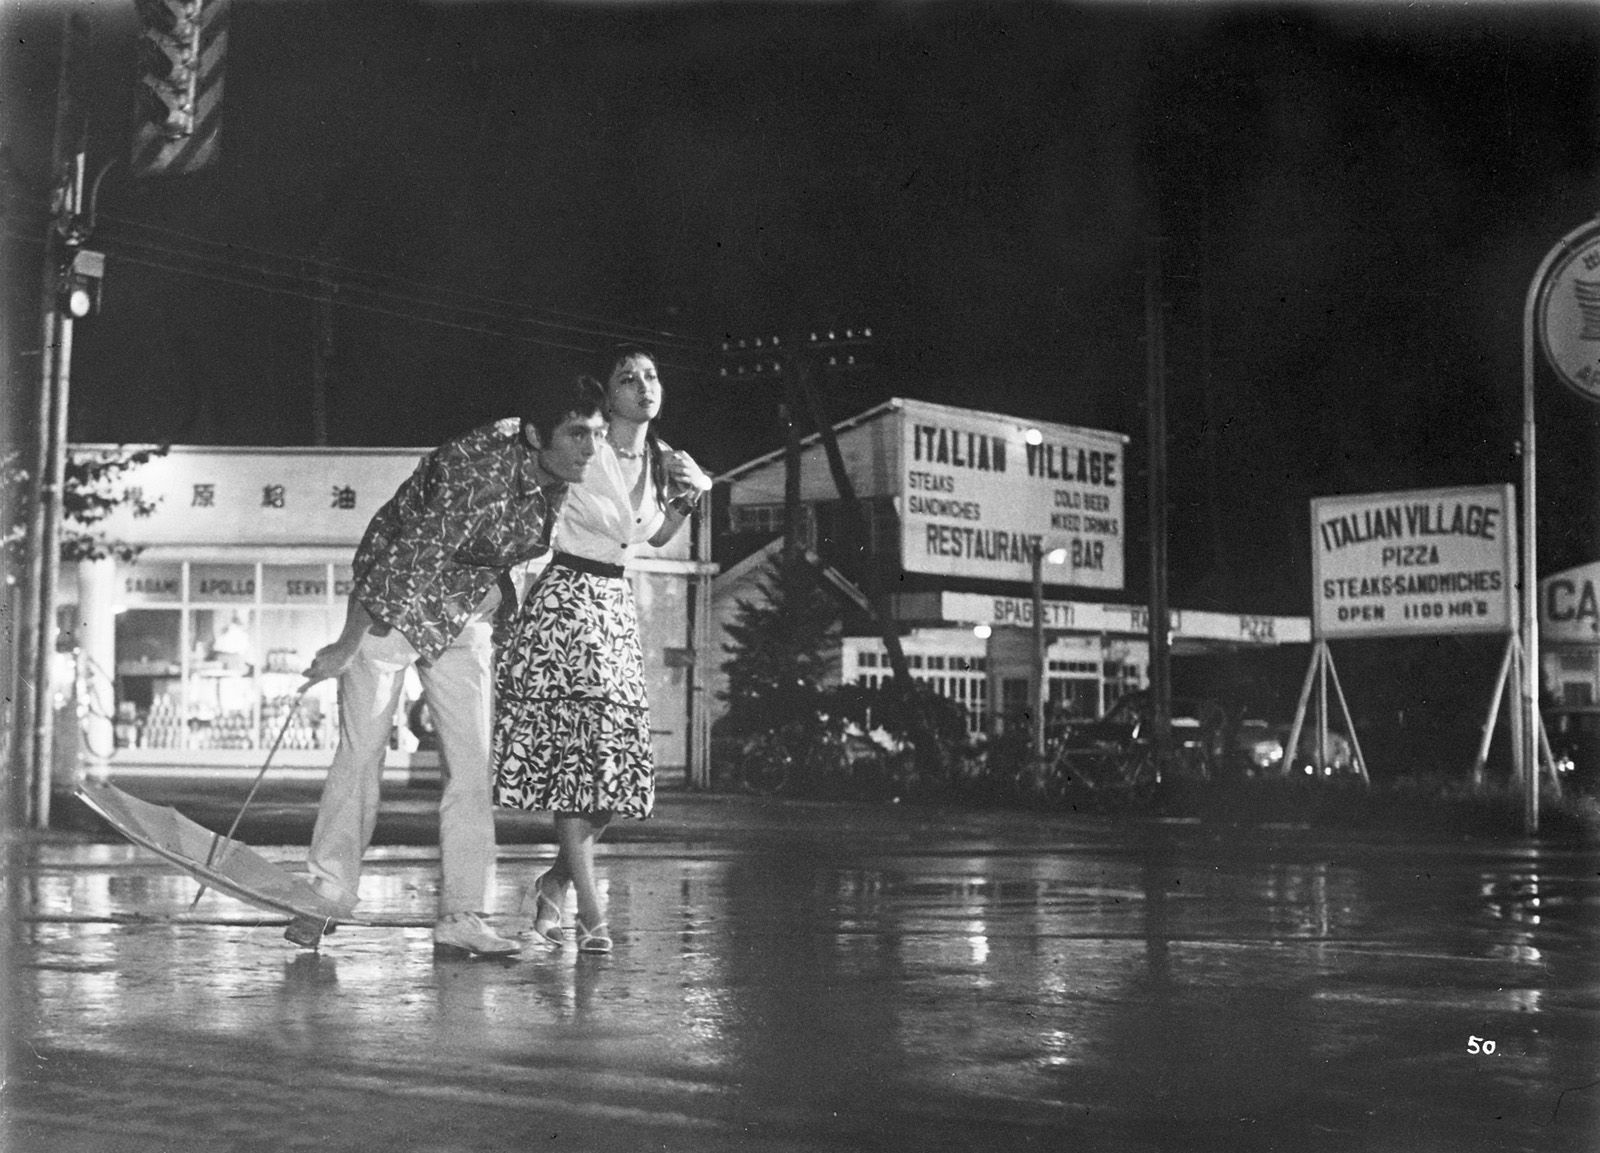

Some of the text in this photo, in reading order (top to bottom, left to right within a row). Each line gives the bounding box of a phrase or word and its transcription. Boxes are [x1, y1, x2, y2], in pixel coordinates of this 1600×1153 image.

[914, 424, 1117, 487] ITALIAN VILLAGE
[909, 471, 954, 493] STEAKS
[909, 495, 981, 521] SANDWICHES
[1054, 489, 1110, 513] COLD BEER
[1321, 503, 1500, 552] ITALIAN VILLAGE
[1072, 539, 1105, 571] BAR
[1382, 545, 1440, 566] PIZZA
[994, 600, 1075, 624] SPAGETTI
[1338, 604, 1385, 622] OPEN
[1404, 602, 1443, 619] 1100
